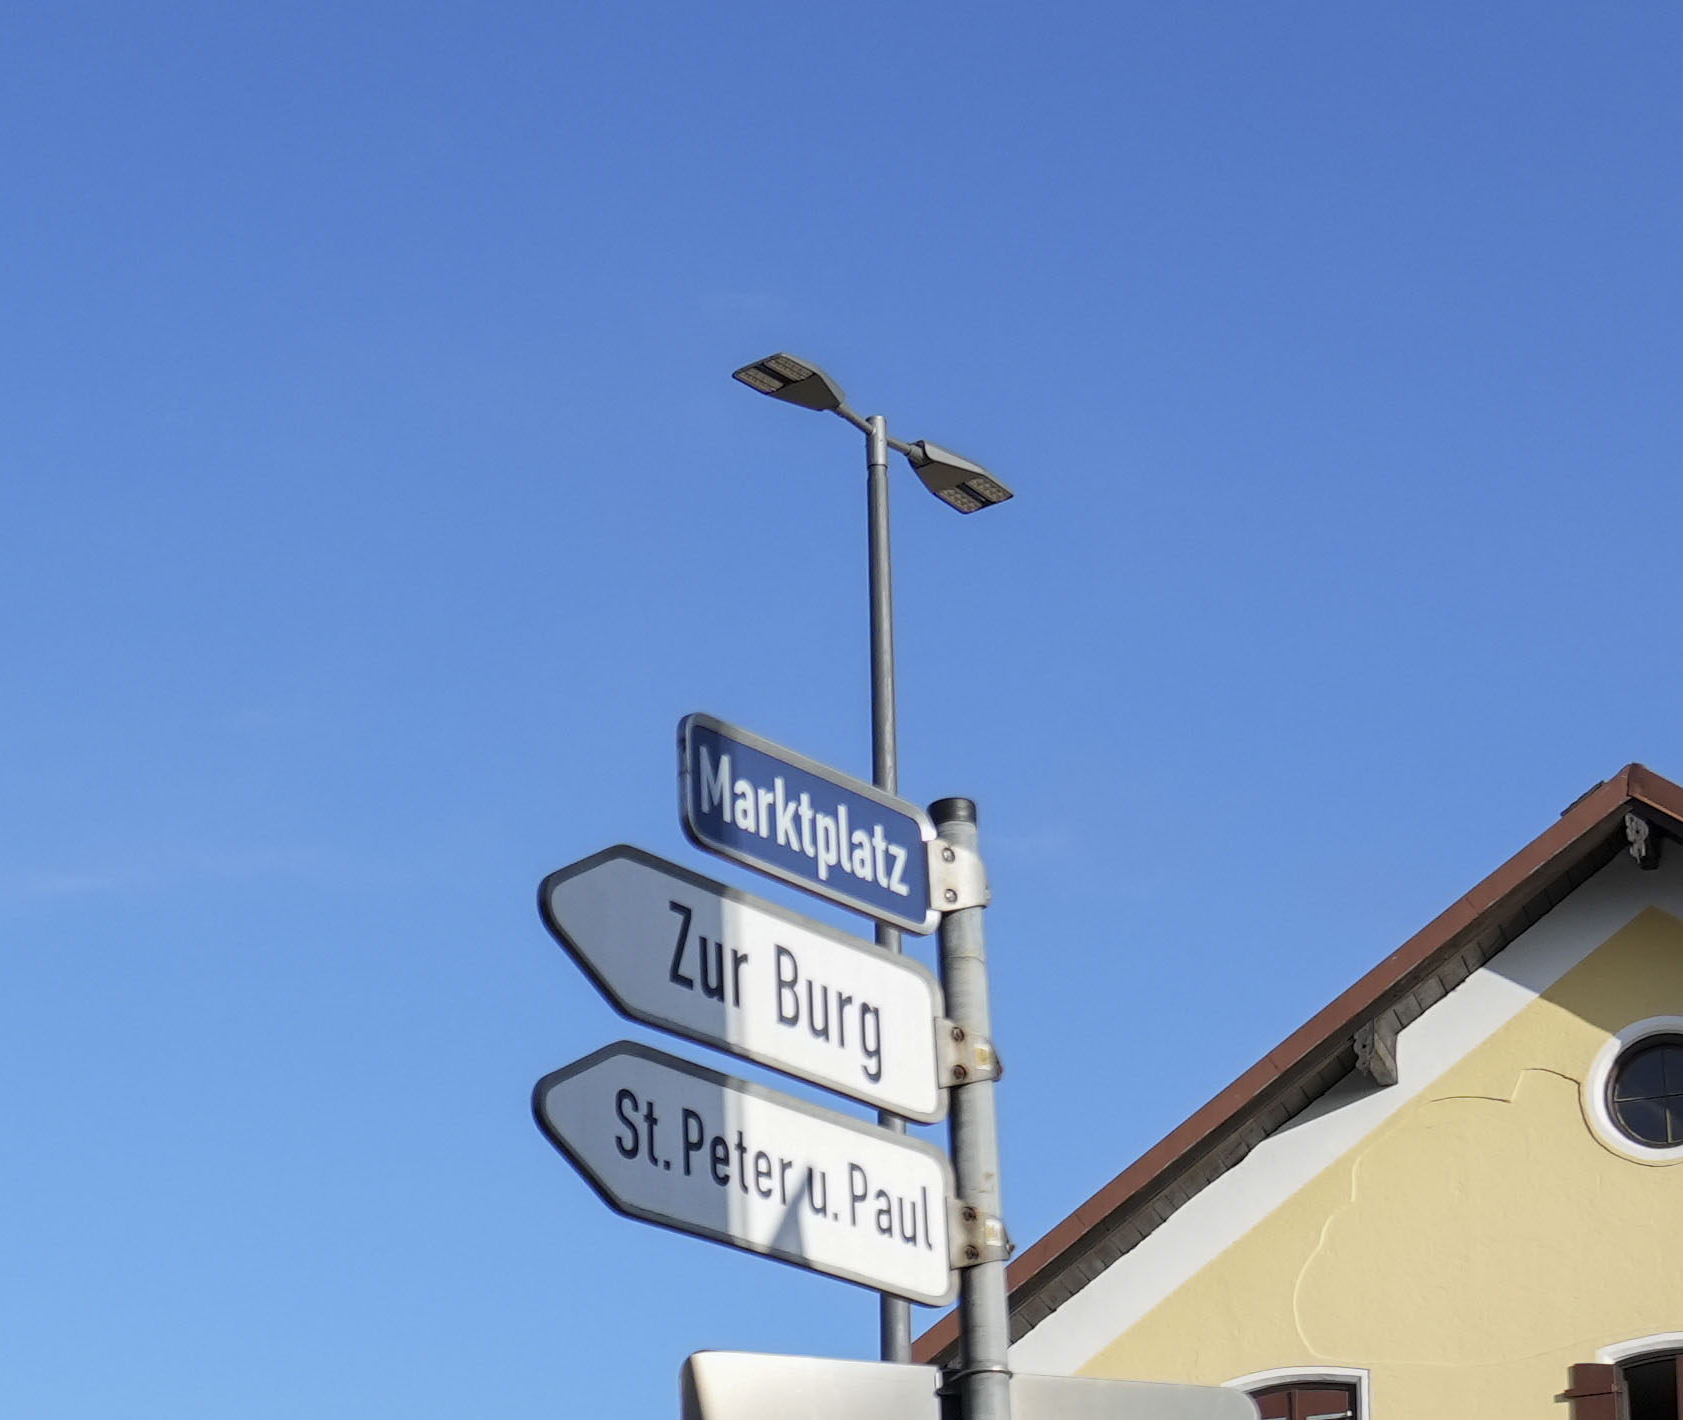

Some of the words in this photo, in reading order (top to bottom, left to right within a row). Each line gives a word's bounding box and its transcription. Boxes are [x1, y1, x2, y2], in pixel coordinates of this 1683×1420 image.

[698, 744, 910, 898] Marktplatz
[668, 899, 749, 1009] Zur
[774, 943, 882, 1084] Burg
[613, 1086, 672, 1172] St.
[682, 1107, 793, 1206] Peter
[807, 1164, 840, 1223] u.
[848, 1162, 934, 1251] Paul
